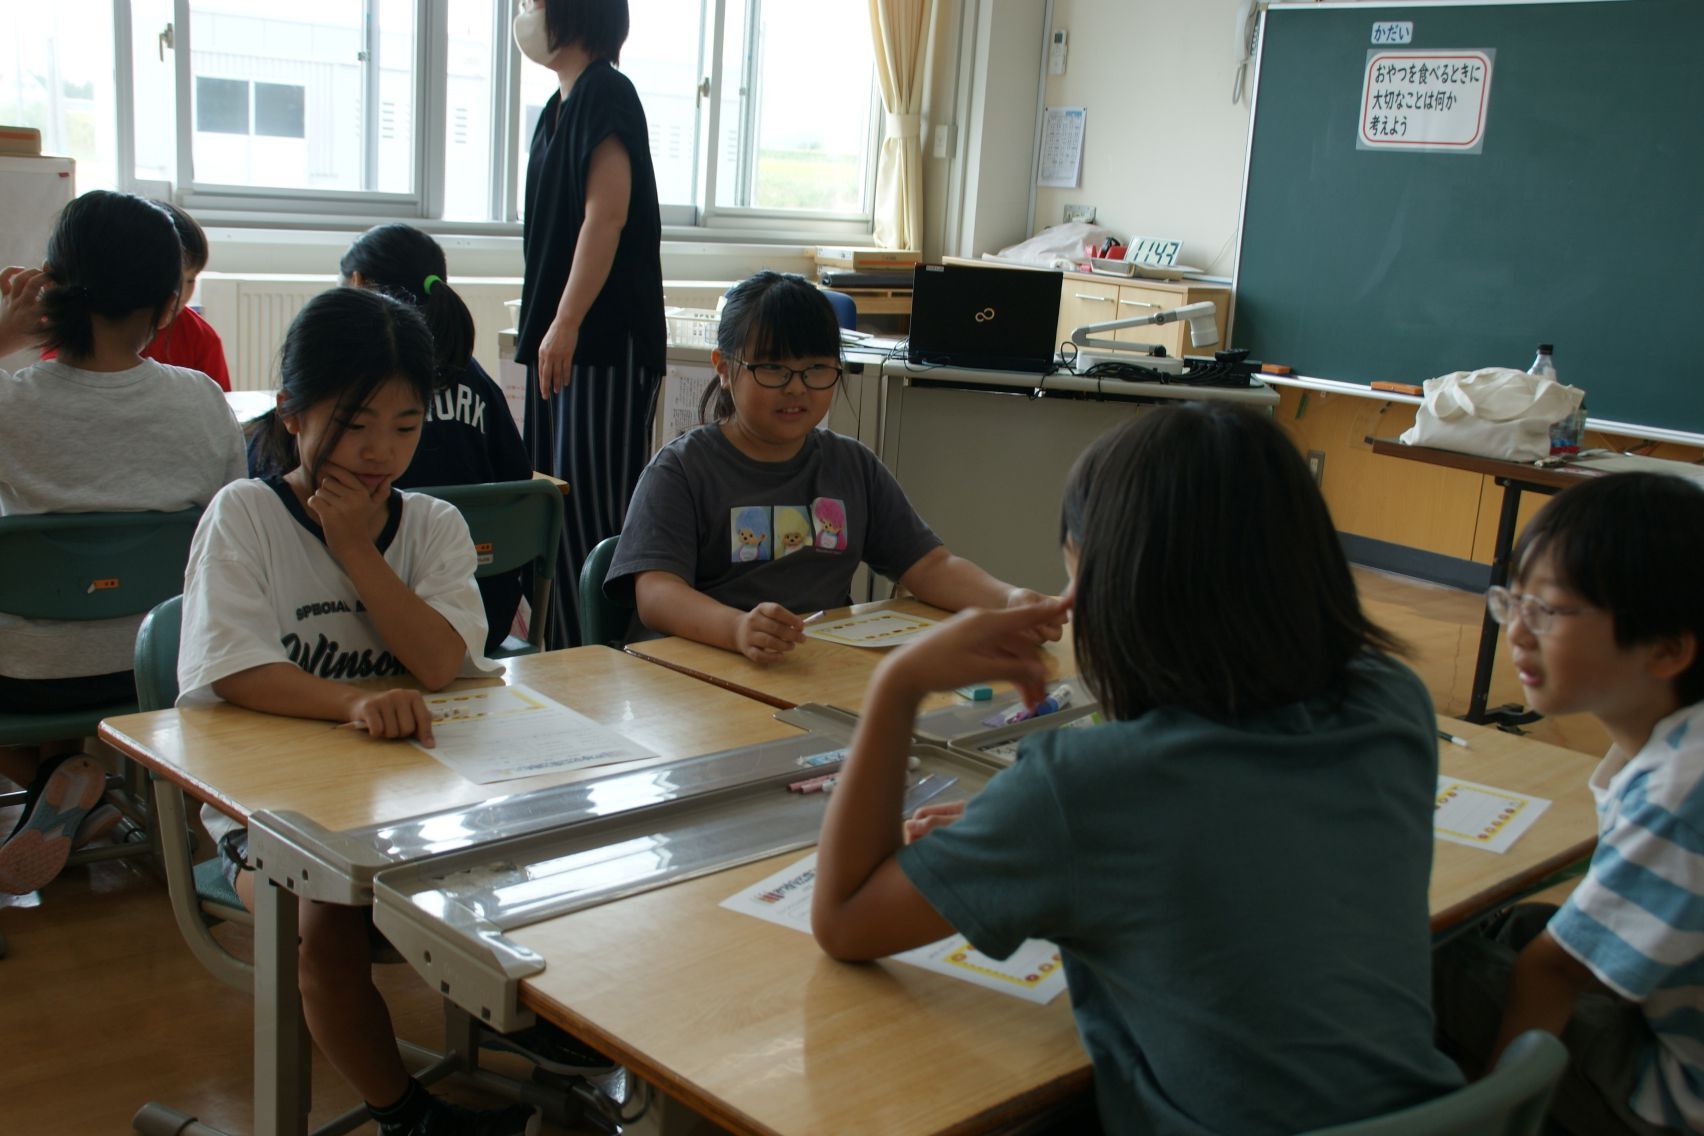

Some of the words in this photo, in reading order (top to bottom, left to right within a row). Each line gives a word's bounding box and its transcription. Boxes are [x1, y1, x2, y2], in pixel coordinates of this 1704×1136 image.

[1374, 24, 1410, 42] かだい
[1375, 63, 1481, 85] おやつを食べるときに
[1372, 89, 1457, 111] 大切なことは何か
[1369, 115, 1408, 136] 考えよう
